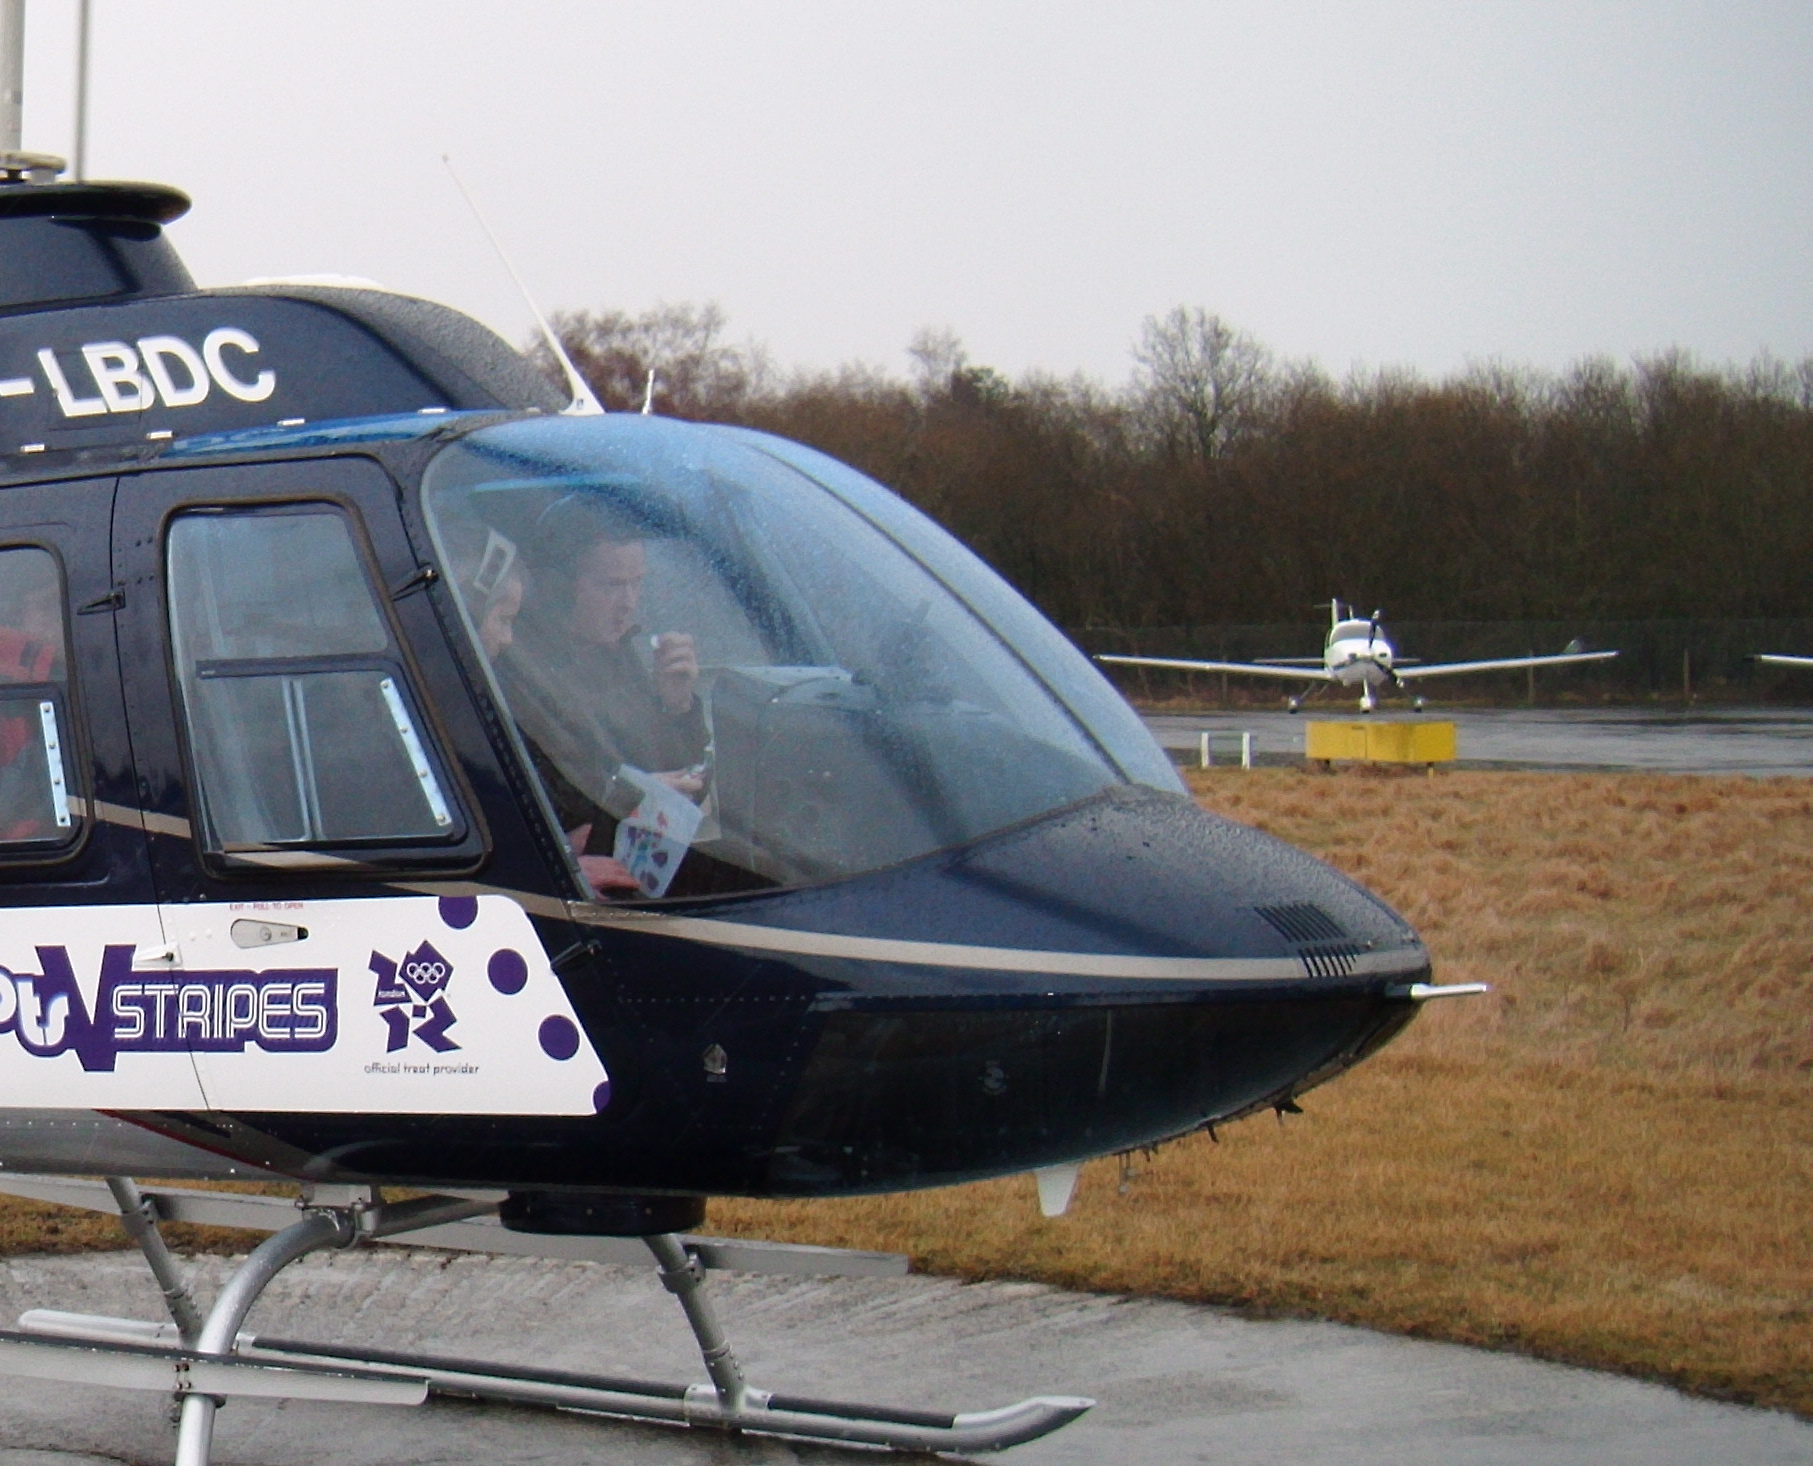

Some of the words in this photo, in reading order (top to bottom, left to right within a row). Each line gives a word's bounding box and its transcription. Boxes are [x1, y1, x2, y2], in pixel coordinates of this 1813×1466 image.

[111, 982, 328, 1040] STRIPES
[364, 1062, 401, 1074] official
[403, 1063, 430, 1074] treat
[433, 1063, 480, 1076] provider
